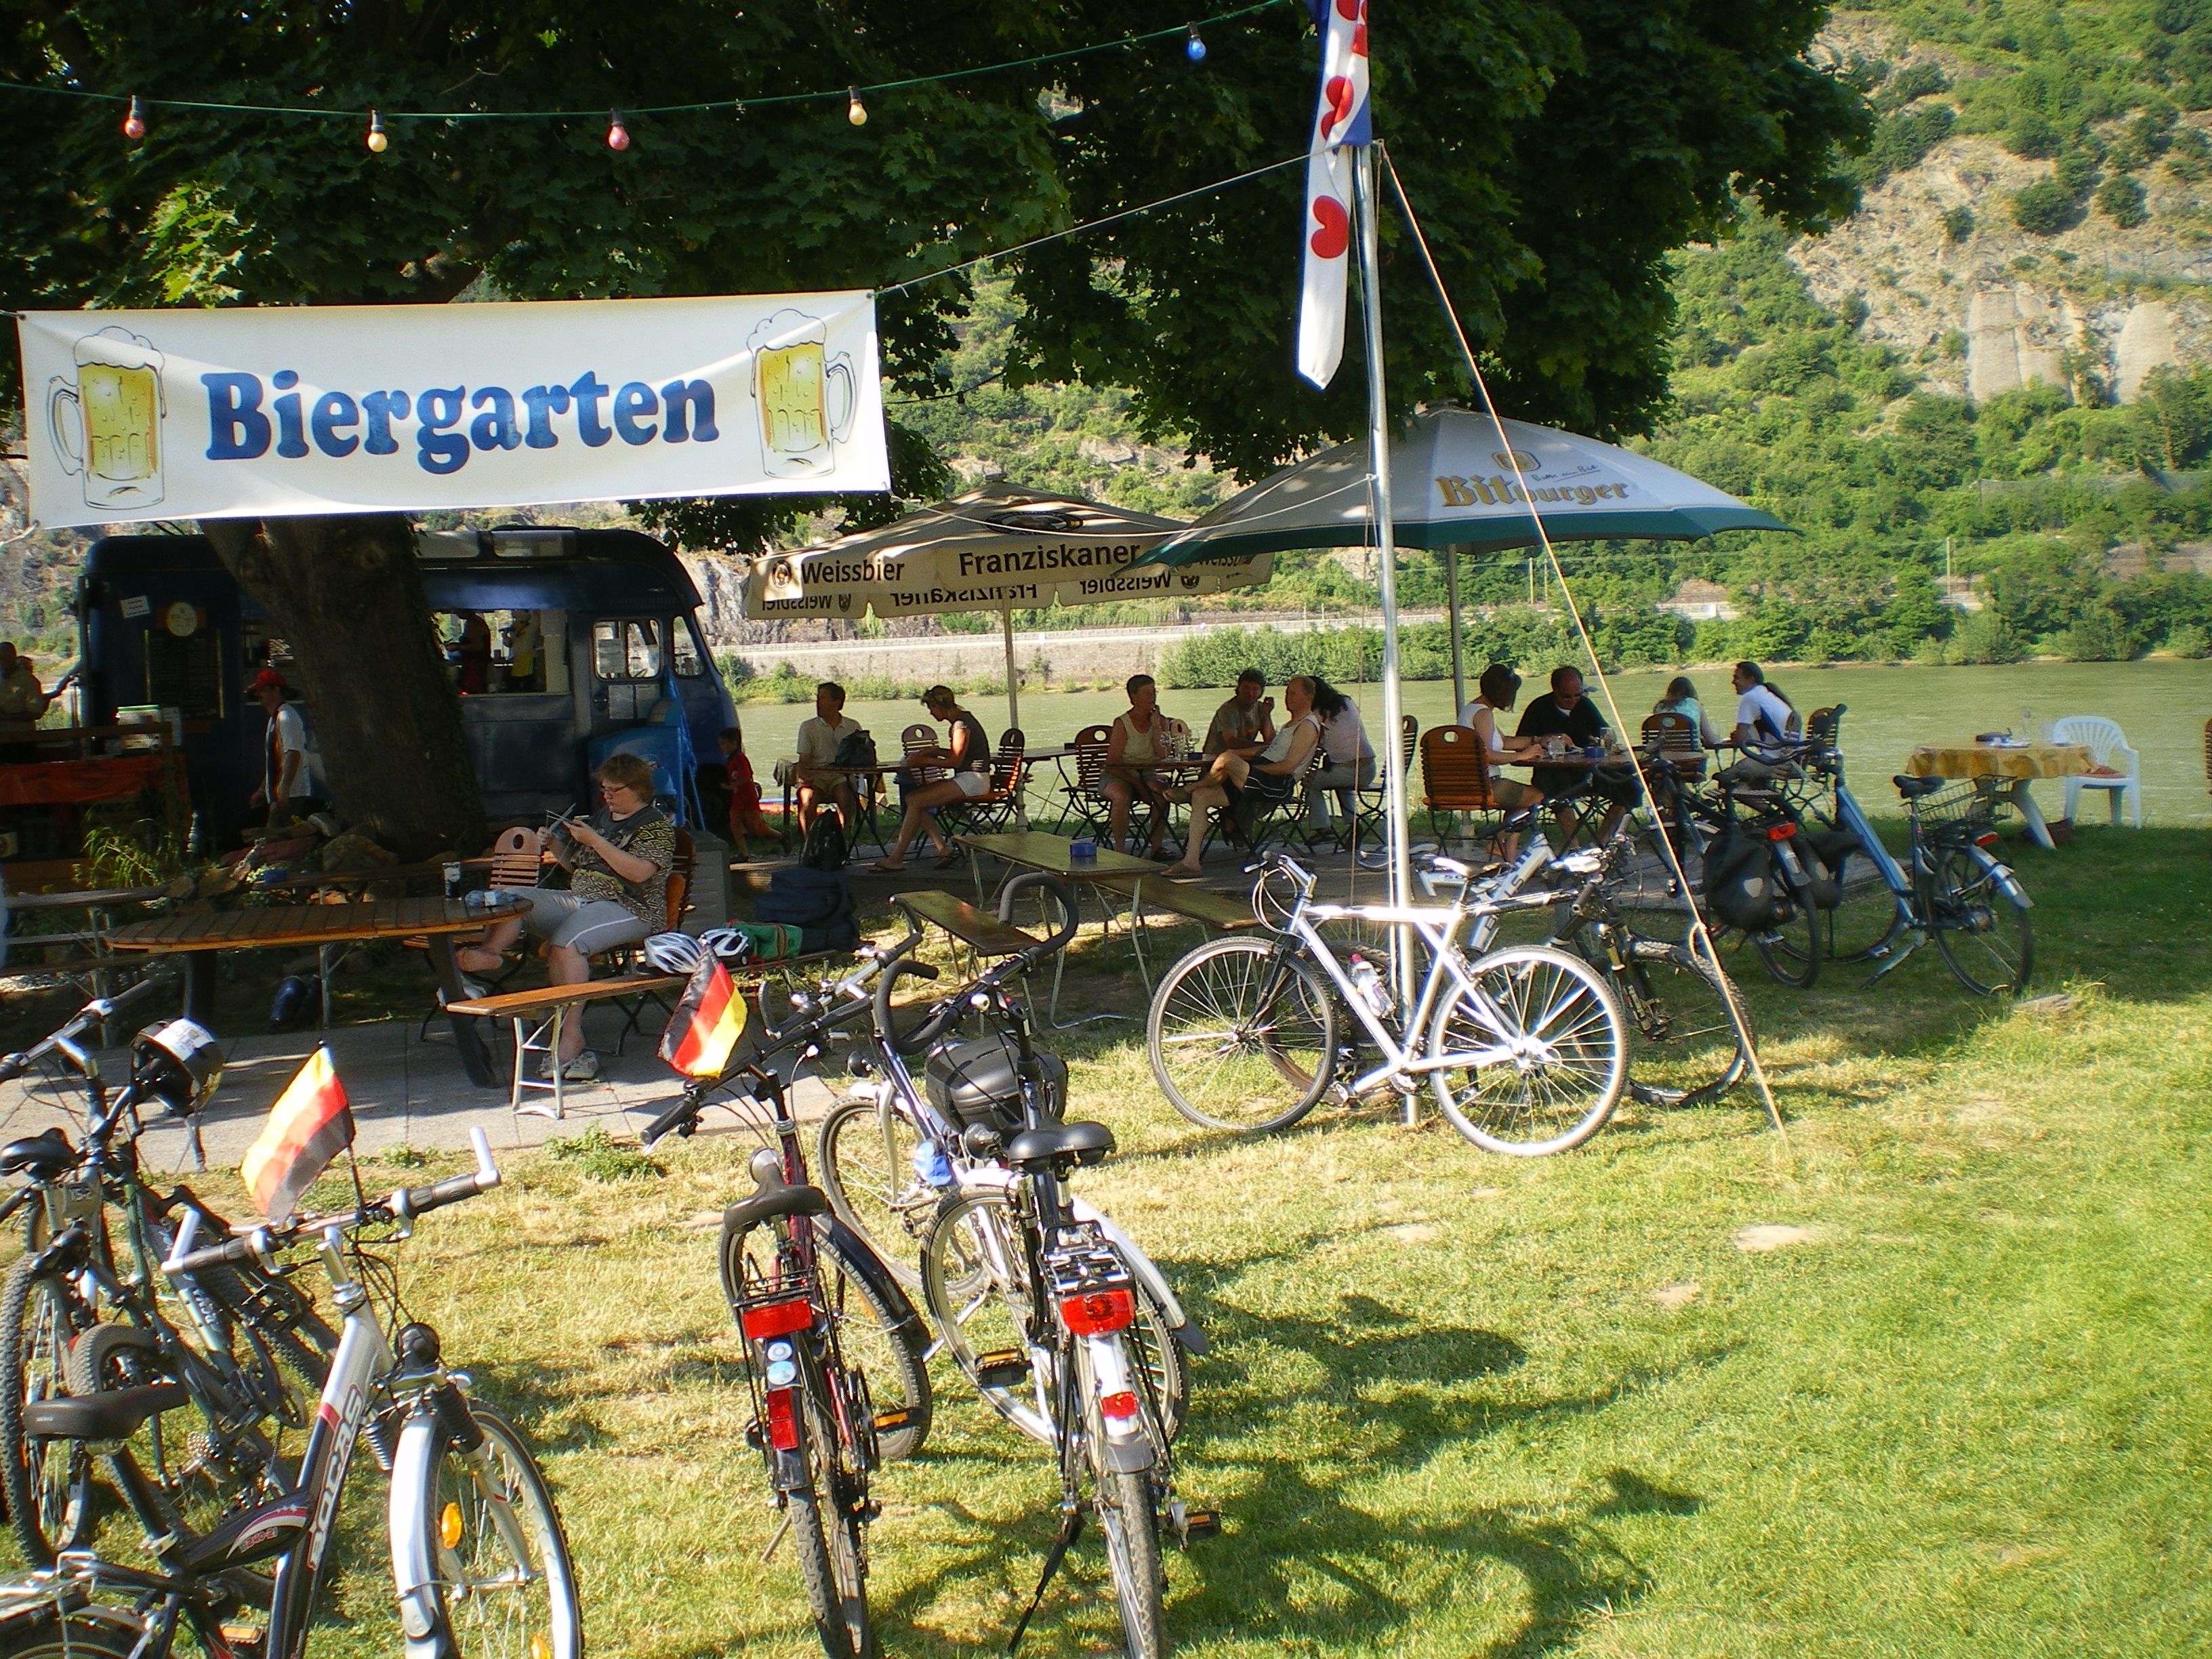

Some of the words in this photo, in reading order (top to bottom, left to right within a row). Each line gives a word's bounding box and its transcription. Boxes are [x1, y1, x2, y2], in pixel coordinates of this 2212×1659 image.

[200, 369, 719, 475] Biergarten
[1435, 474, 1631, 507] Bitburger
[801, 559, 905, 584] Weissbier
[959, 544, 1141, 576] Franziskaner
[307, 1384, 365, 1571] BOCAS
